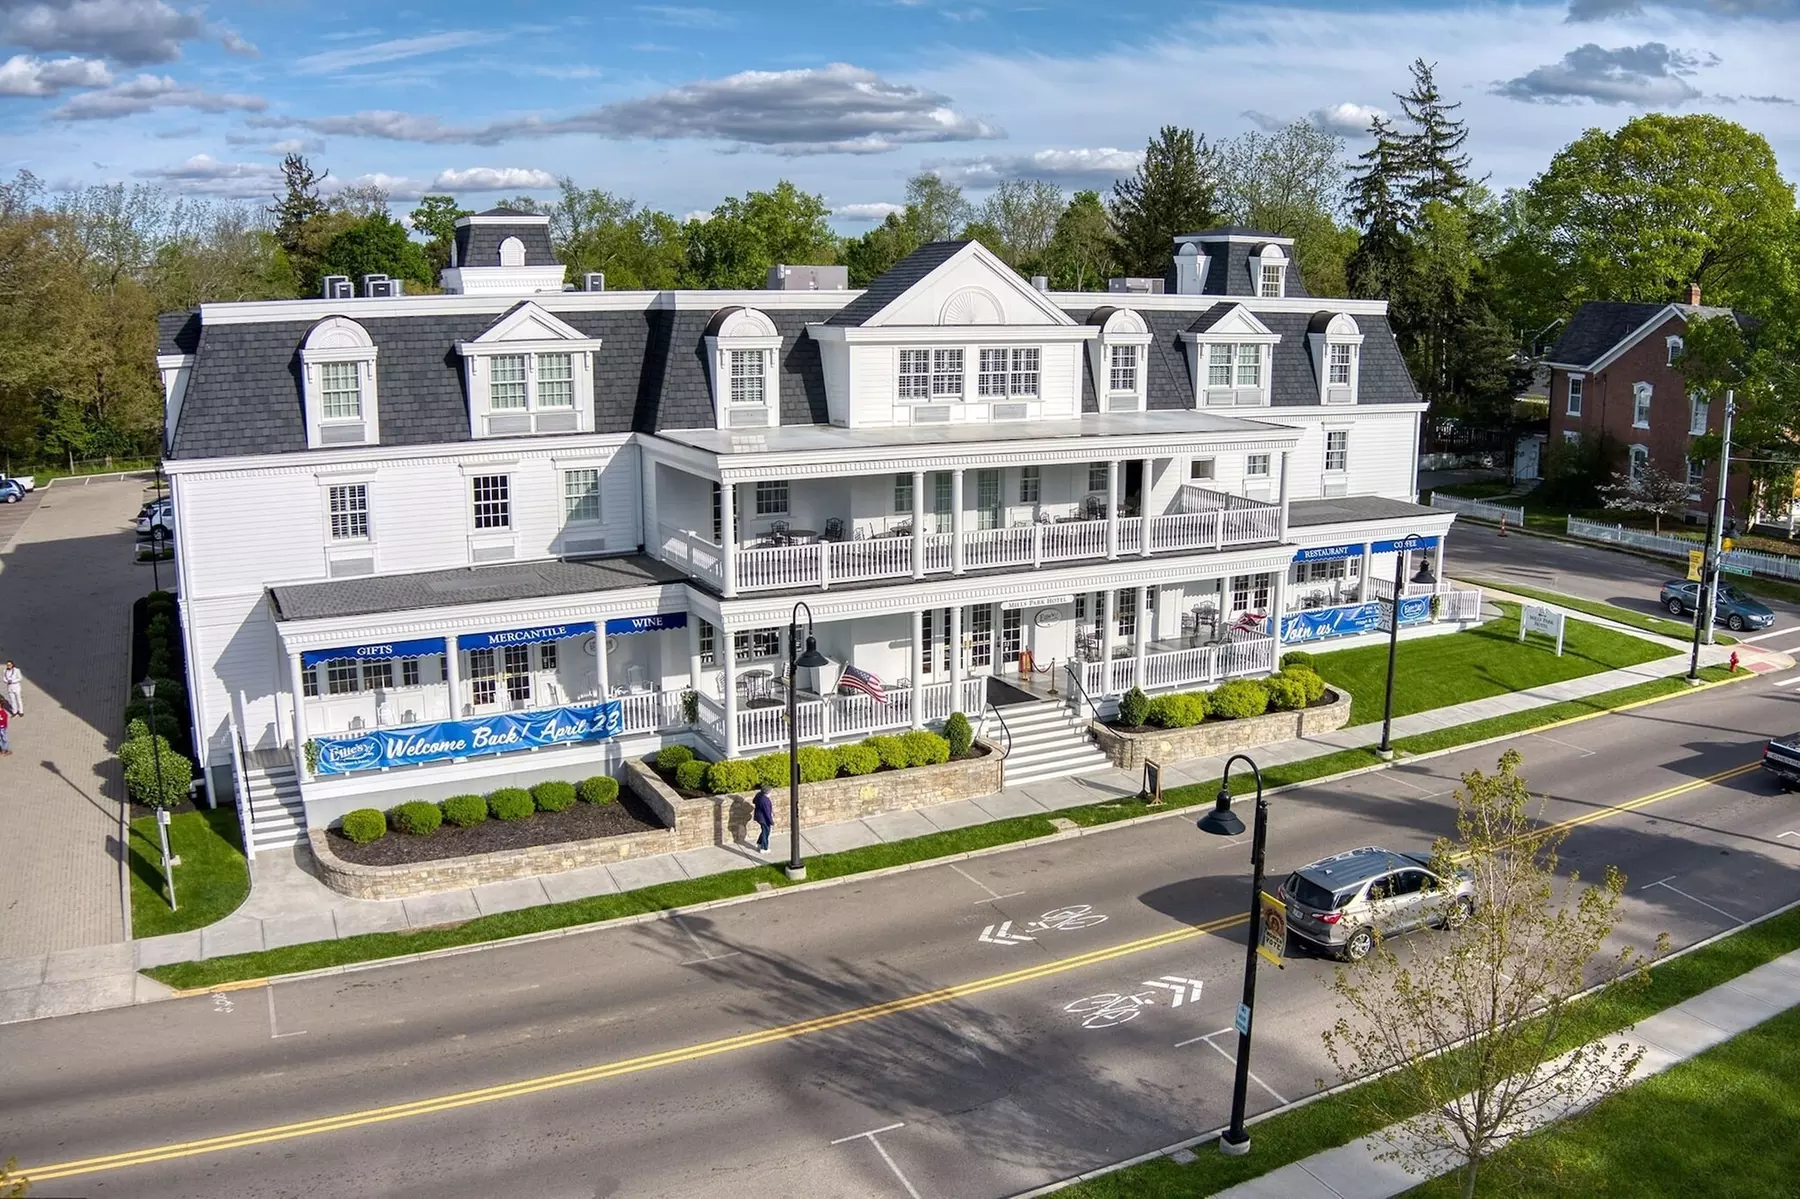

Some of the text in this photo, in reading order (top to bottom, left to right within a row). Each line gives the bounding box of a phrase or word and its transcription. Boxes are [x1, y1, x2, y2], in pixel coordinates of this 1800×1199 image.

[1304, 547, 1348, 558] RESTAURANT
[632, 617, 663, 629] WINE
[1281, 613, 1342, 642] Join us!
[488, 626, 566, 644] MERCANTILE
[357, 644, 393, 656] GIFTS
[387, 711, 620, 759] Welcome Back! April 23
